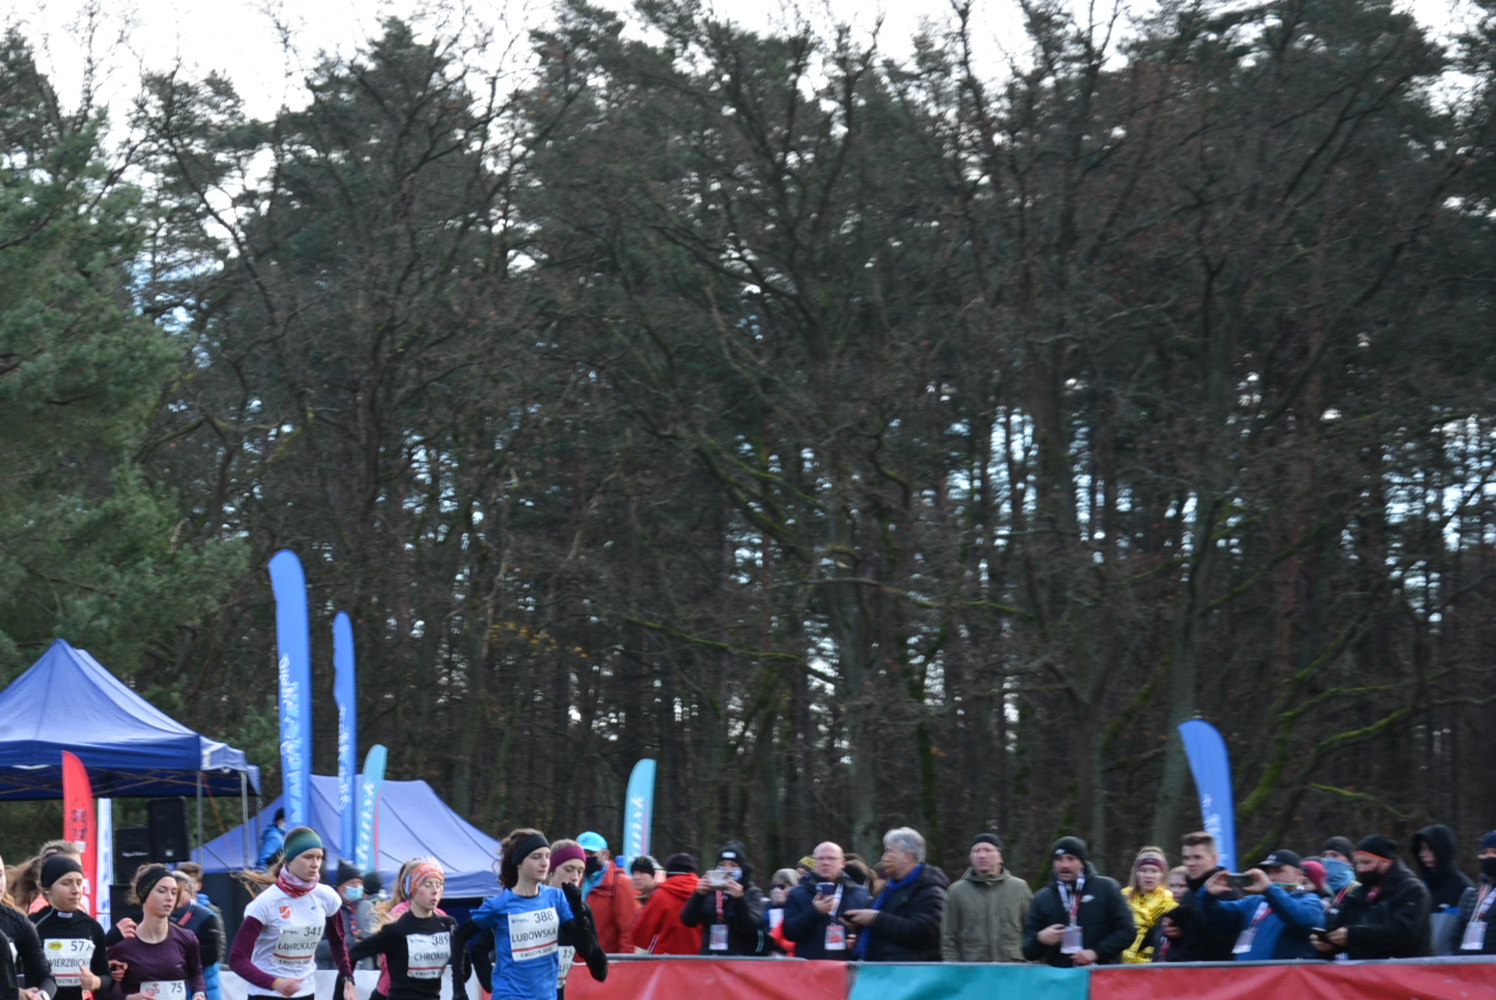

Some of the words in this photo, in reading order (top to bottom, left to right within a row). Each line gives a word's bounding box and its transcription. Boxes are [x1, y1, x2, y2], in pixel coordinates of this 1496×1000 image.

[534, 911, 554, 923] 388
[304, 926, 322, 936] 341
[171, 983, 183, 993] 75
